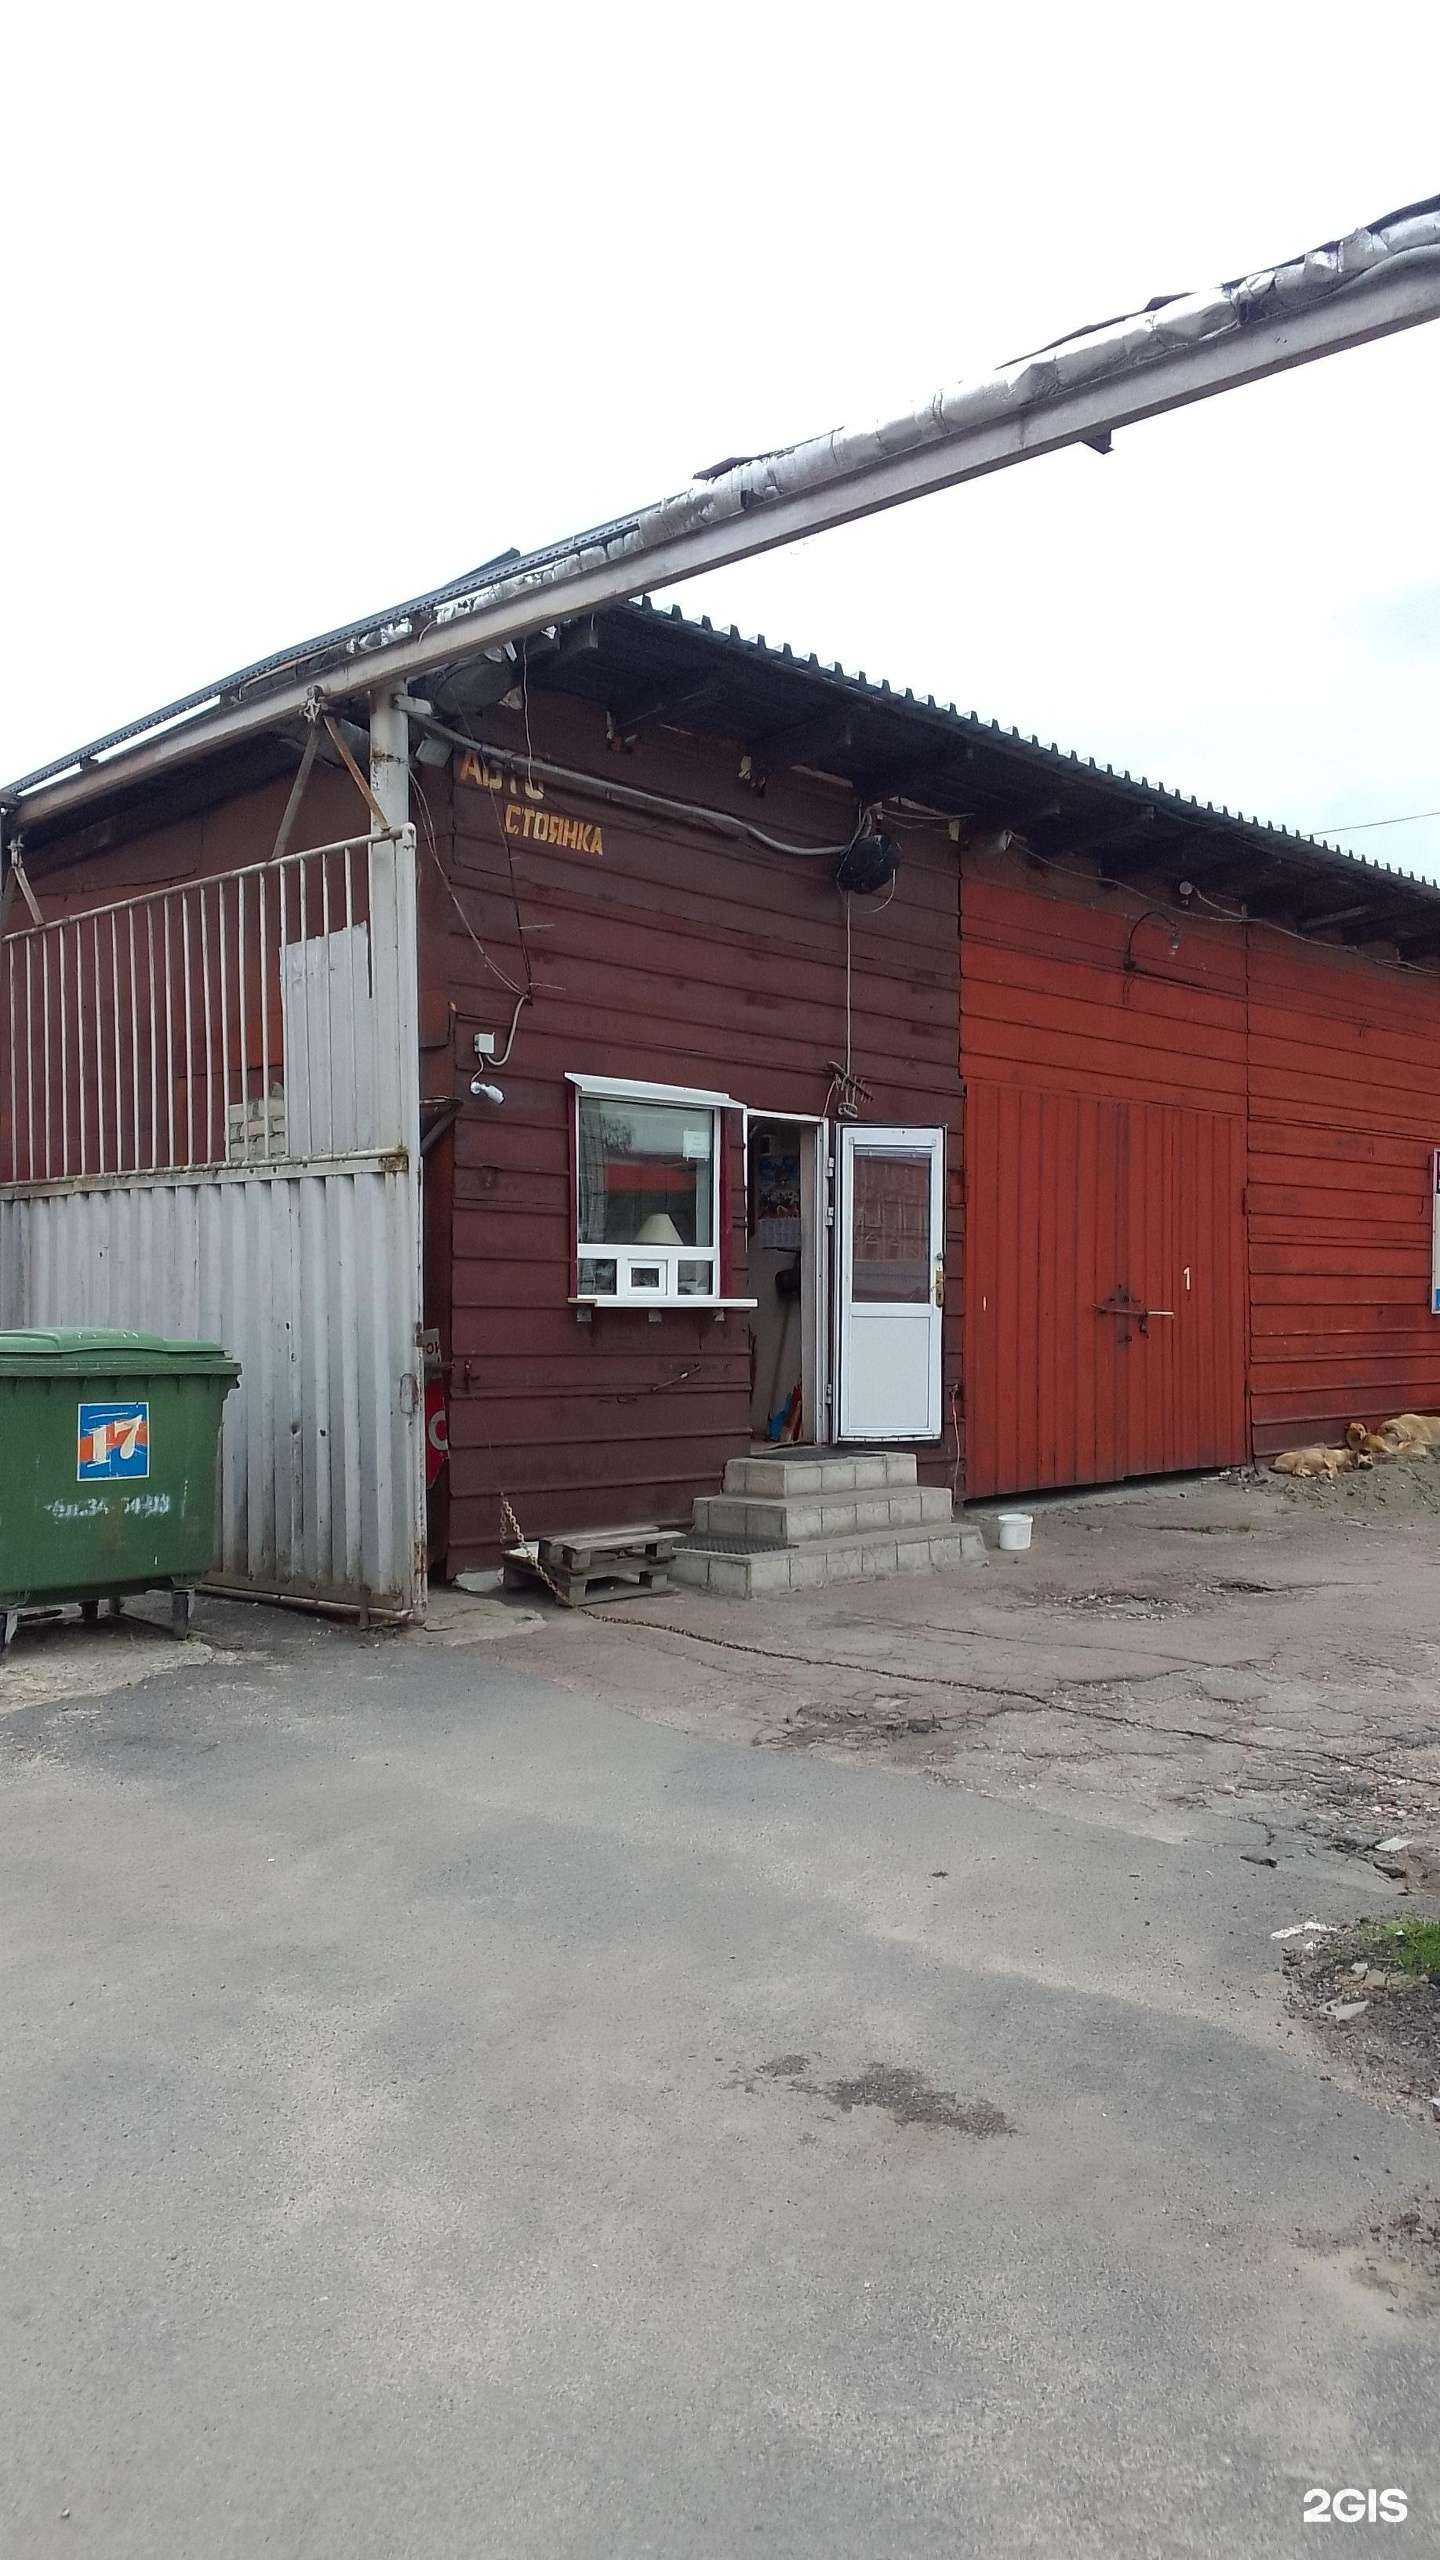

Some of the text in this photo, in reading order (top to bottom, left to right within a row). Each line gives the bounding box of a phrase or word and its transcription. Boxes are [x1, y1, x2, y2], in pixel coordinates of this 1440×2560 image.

[504, 803, 604, 856] СТОЯНКА
[1183, 1266, 1191, 1290] 1
[87, 1414, 143, 1468] 17
